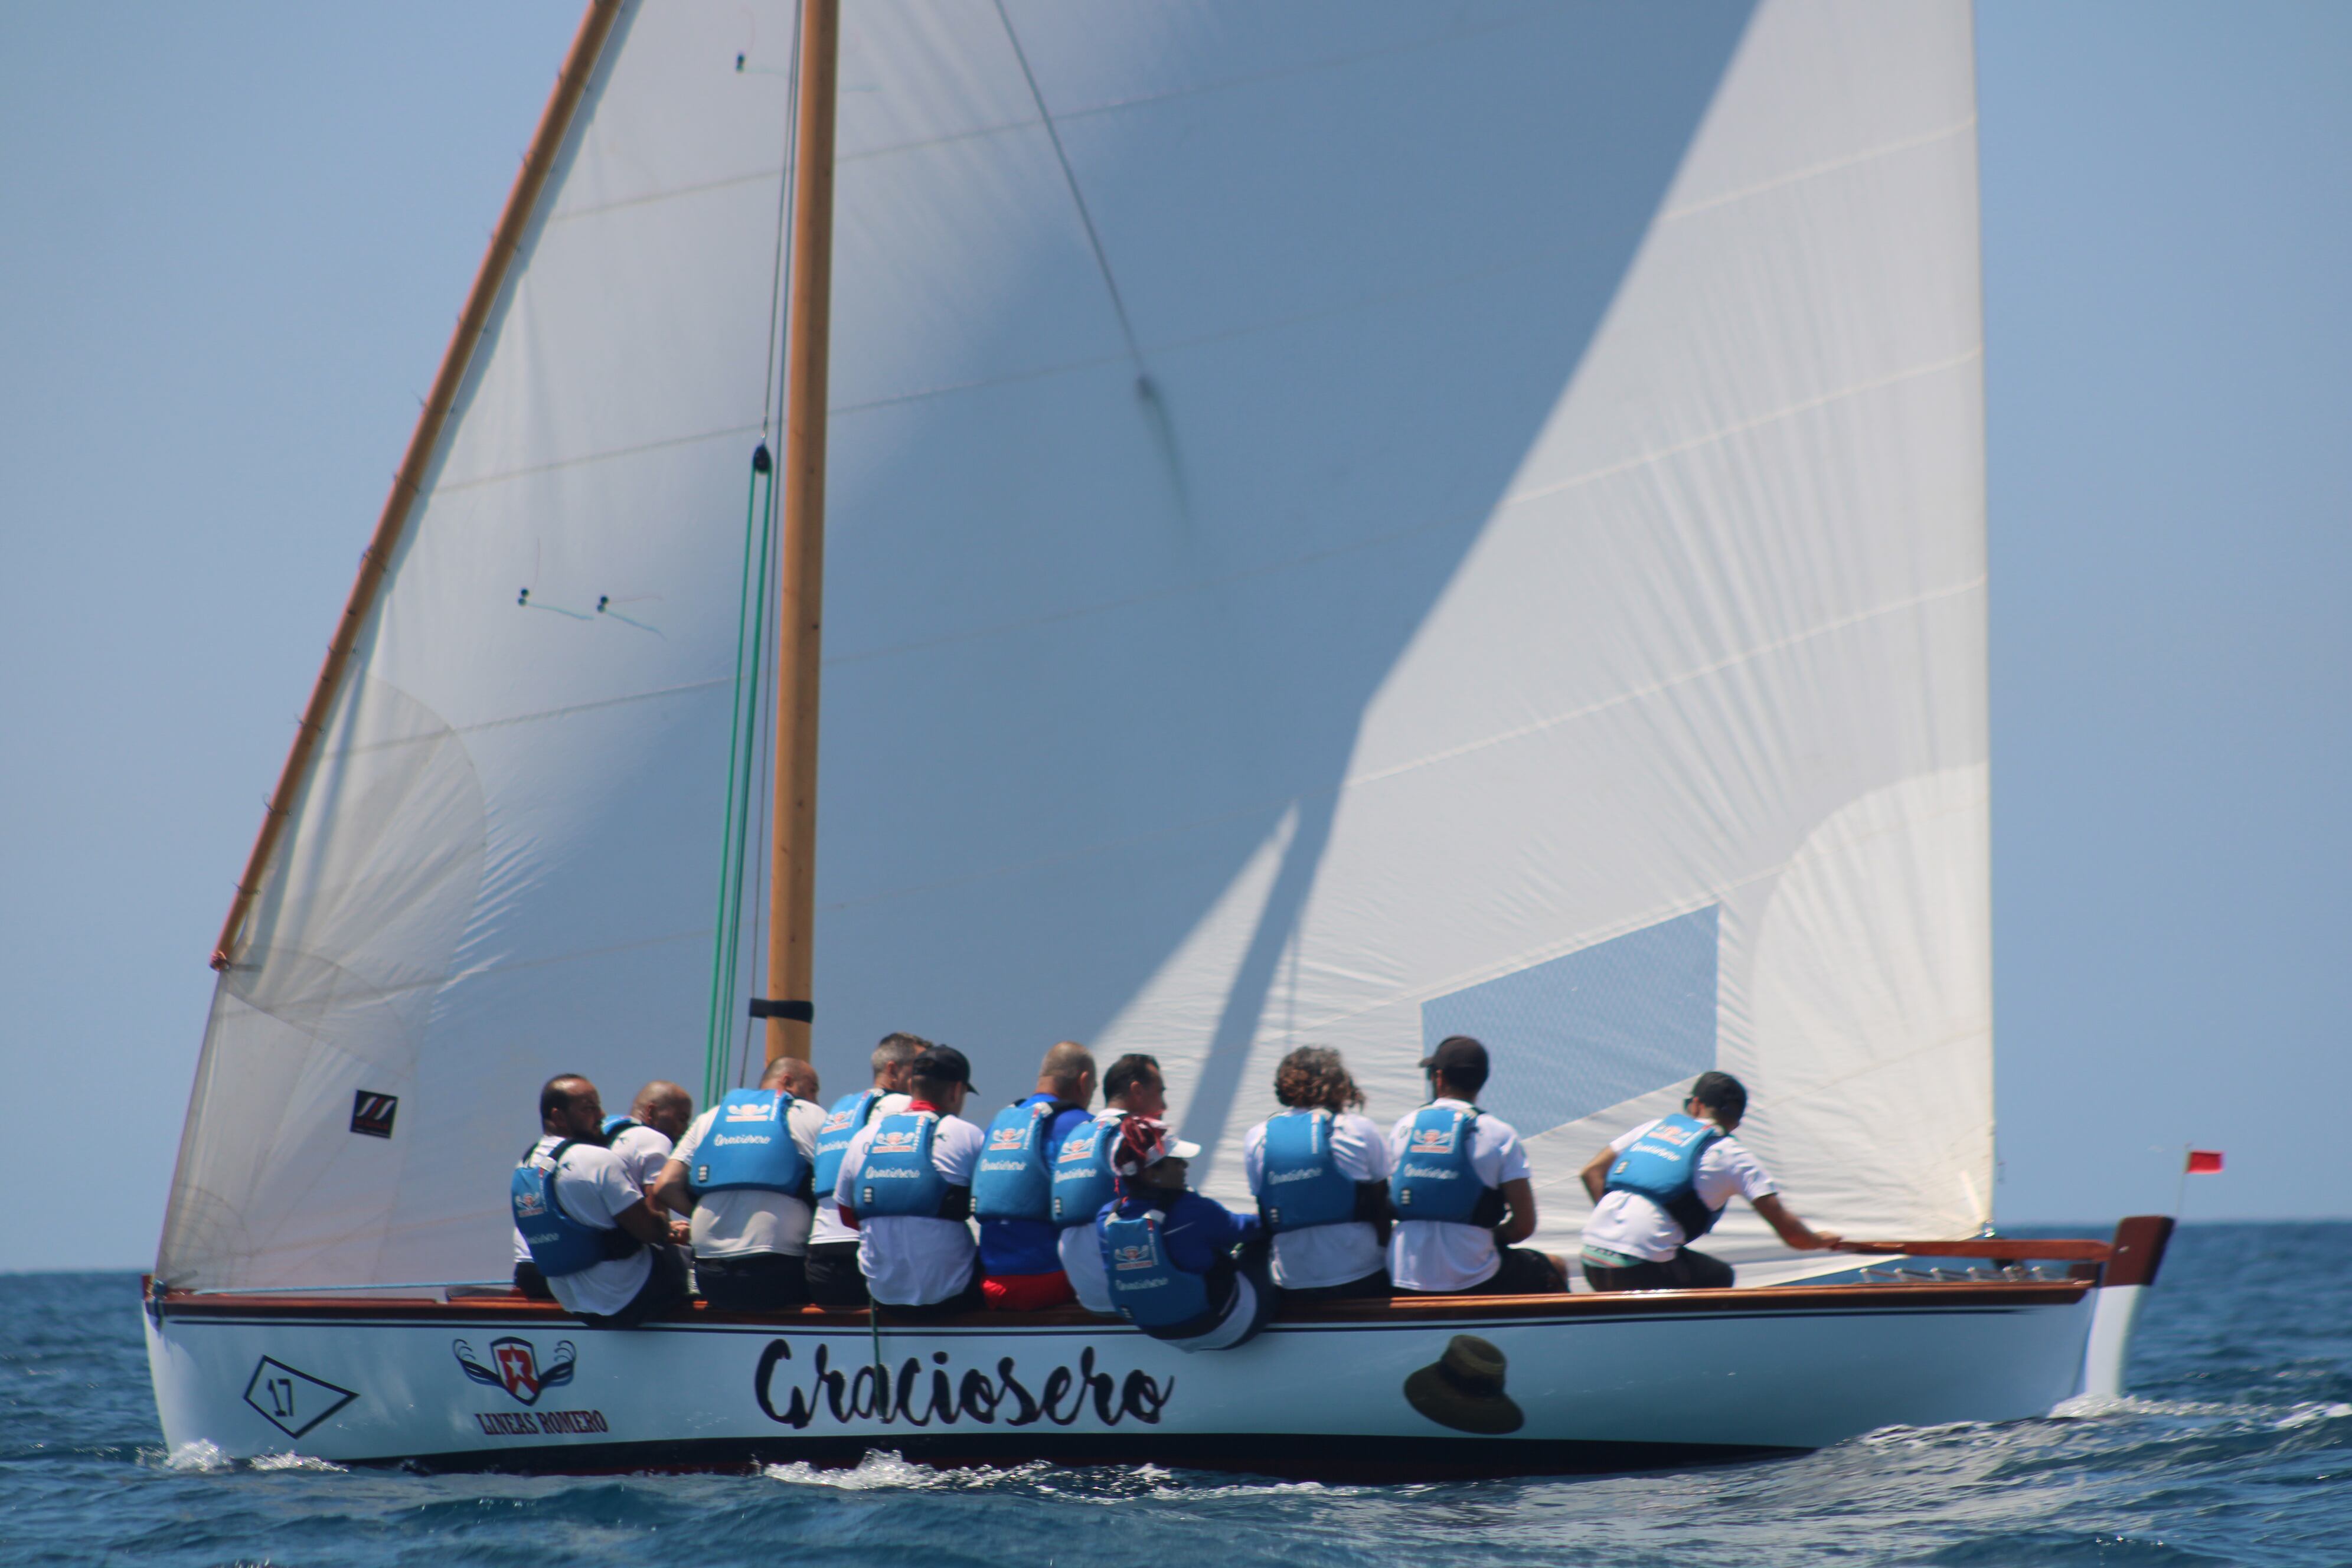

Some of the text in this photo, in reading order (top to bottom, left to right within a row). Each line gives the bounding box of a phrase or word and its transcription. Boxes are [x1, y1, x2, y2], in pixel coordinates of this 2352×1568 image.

[267, 1378, 294, 1417] 17
[754, 1338, 1175, 1429] Graciosero
[474, 1409, 609, 1435] LINEAS ROMERO
